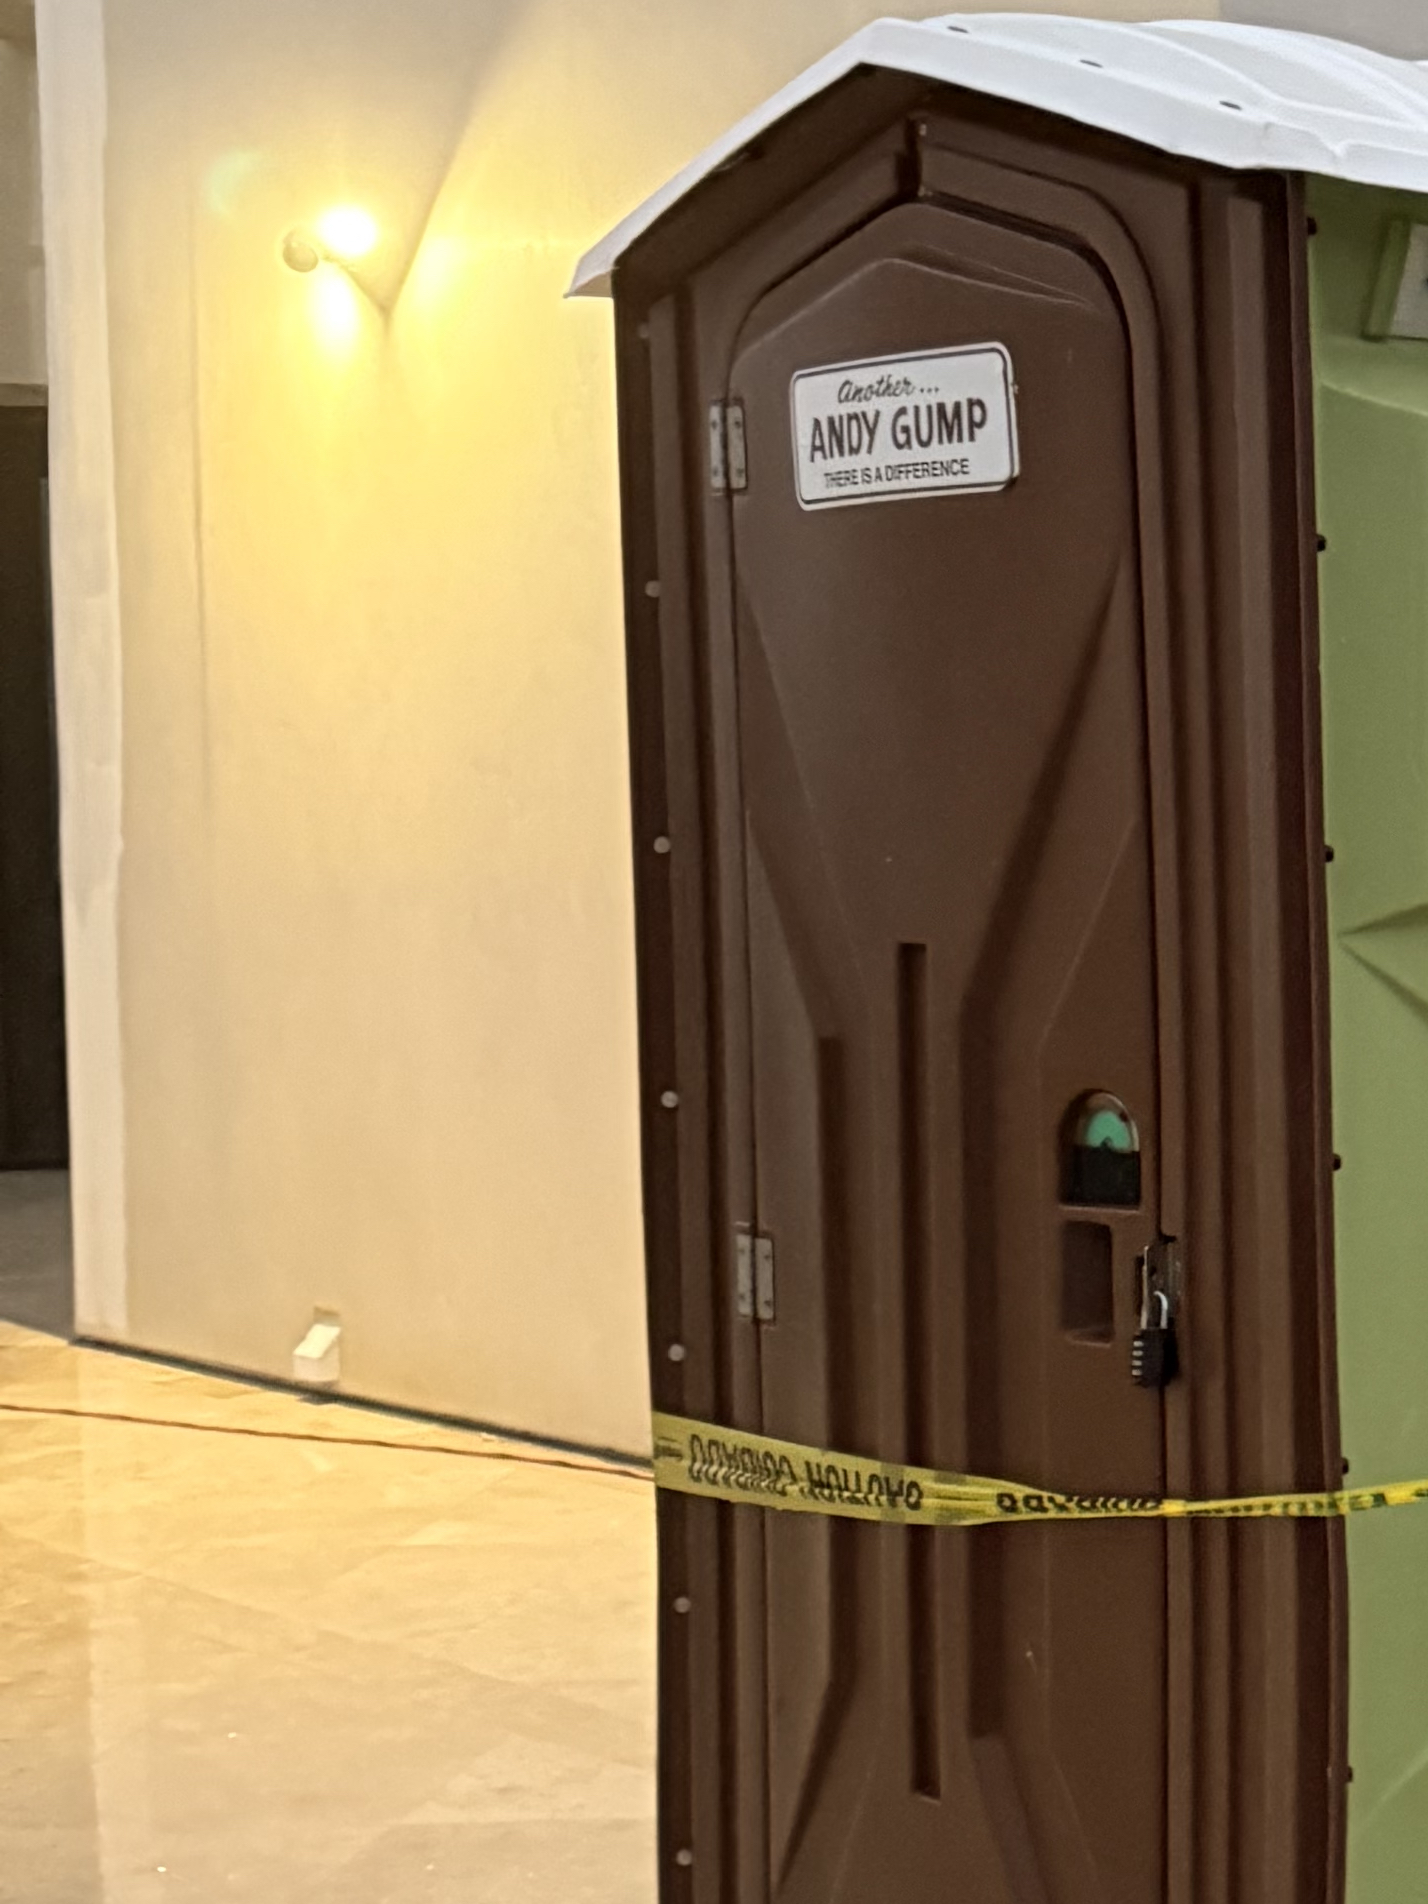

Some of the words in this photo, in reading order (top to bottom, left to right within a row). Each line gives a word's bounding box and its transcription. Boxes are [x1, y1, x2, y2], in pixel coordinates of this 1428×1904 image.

[810, 409, 881, 463] ANDY
[891, 397, 988, 451] GUMP
[824, 468, 859, 488] THERE
[860, 465, 873, 486] IS
[875, 466, 883, 482] A
[885, 458, 970, 481] DIFFERENCE
